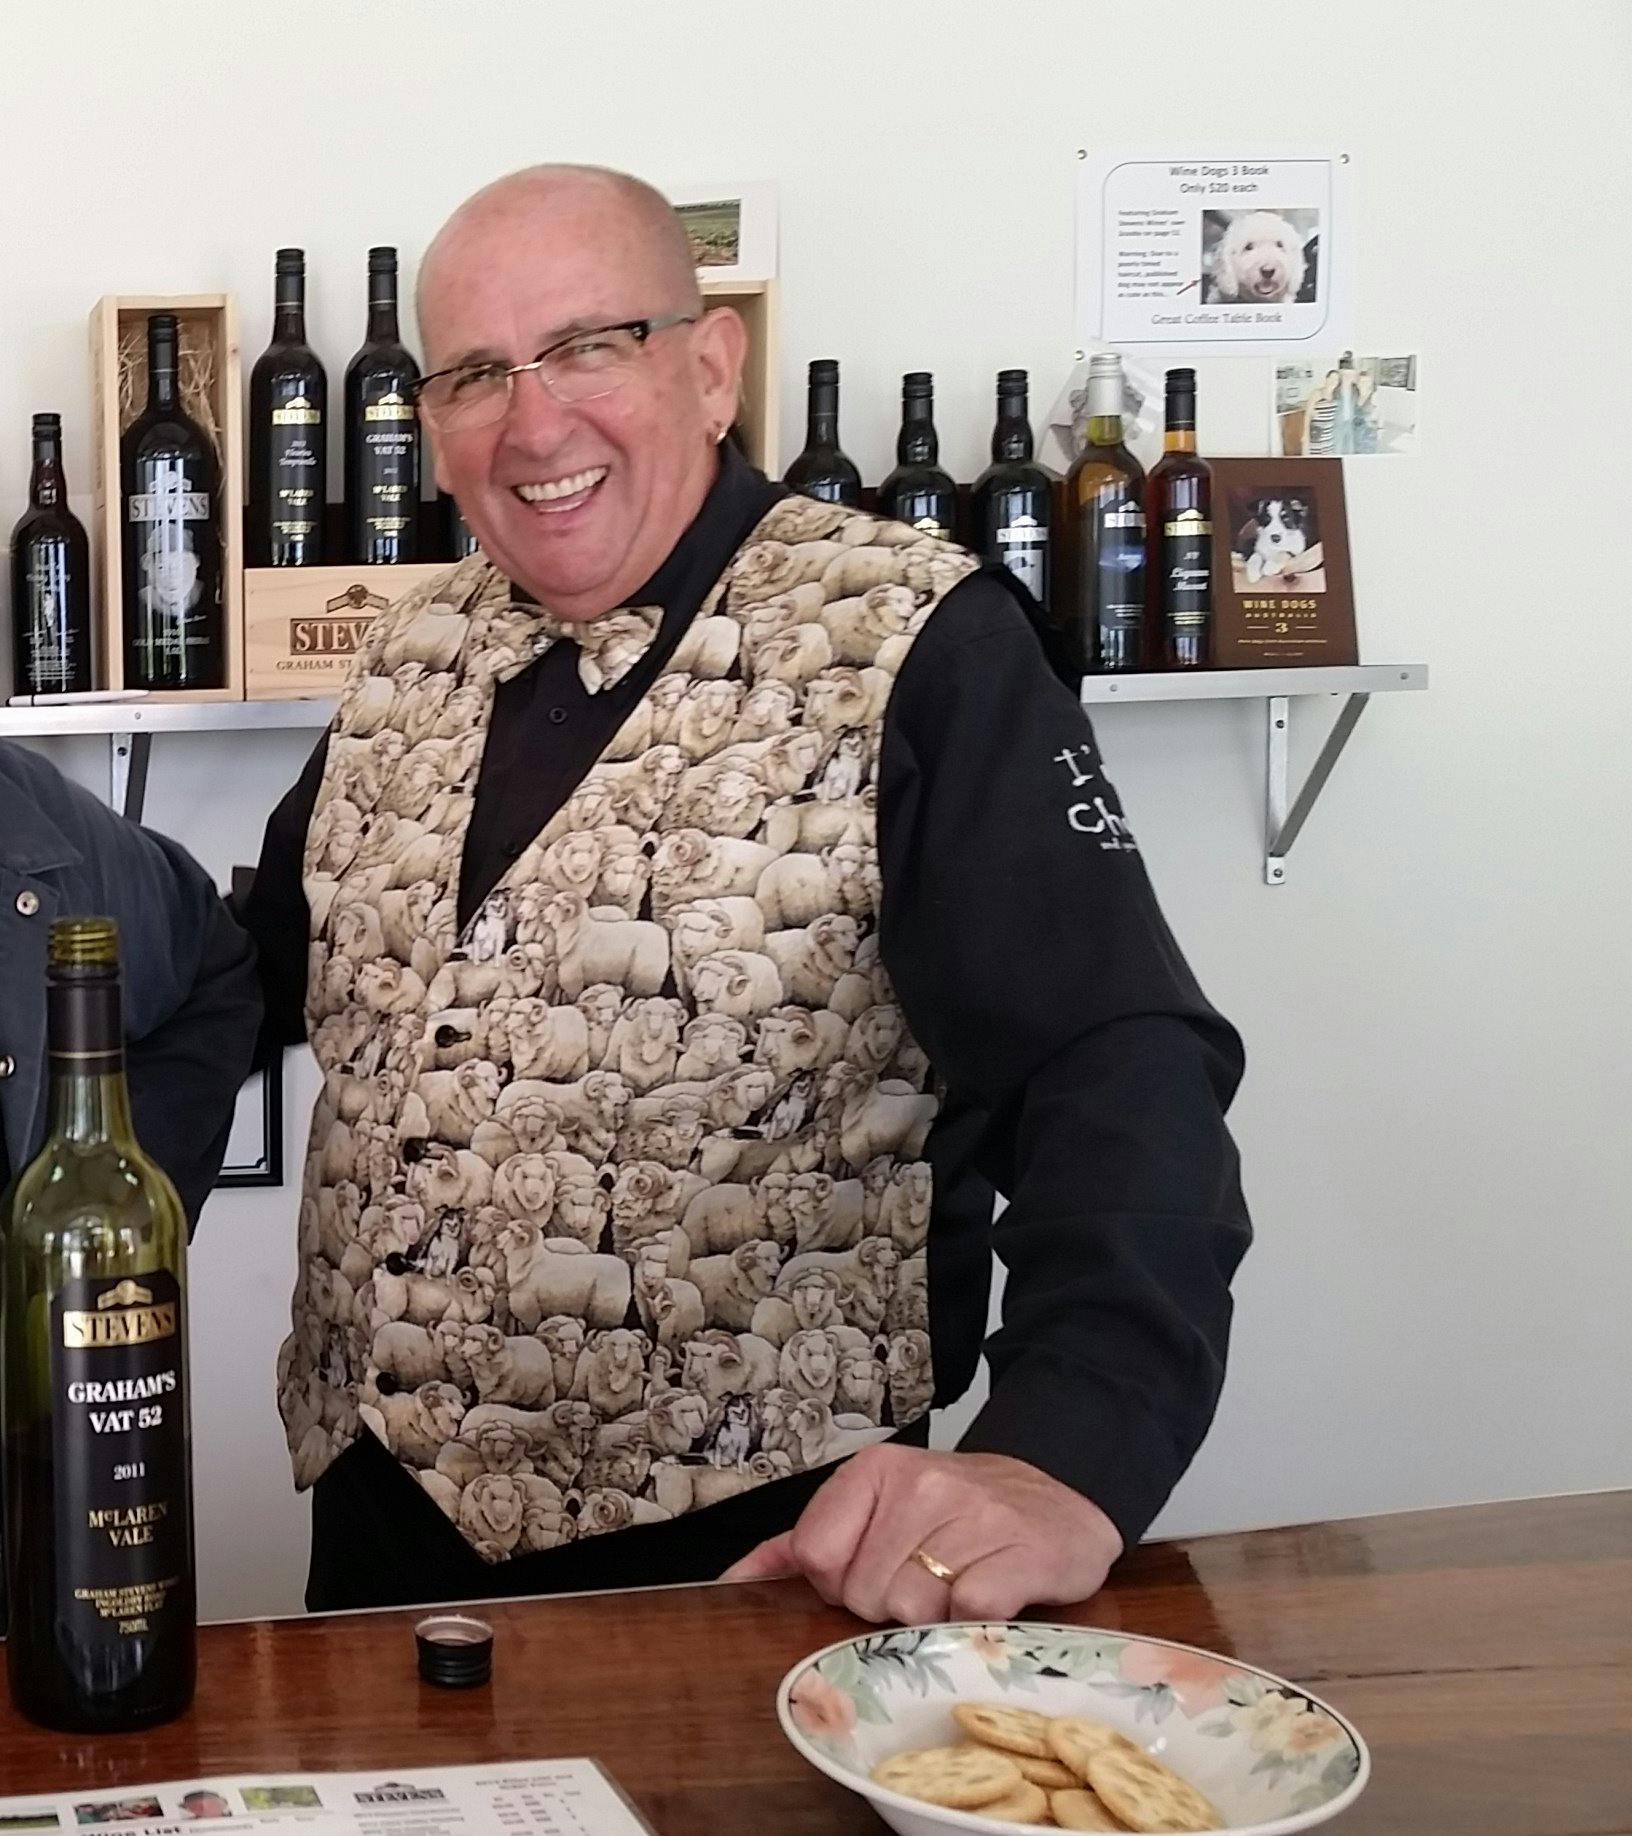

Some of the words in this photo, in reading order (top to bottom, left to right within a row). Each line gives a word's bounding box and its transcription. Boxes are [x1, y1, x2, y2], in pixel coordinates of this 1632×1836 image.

[1170, 166, 1197, 176] Wine
[1201, 166, 1229, 178] Dogs
[1232, 166, 1239, 176] 3
[1242, 165, 1269, 176] Book
[1180, 183, 1206, 195] Only
[1209, 182, 1230, 194] $20
[1233, 183, 1259, 193] each
[1151, 313, 1182, 325] Great
[1185, 313, 1219, 324] Coffee
[1222, 312, 1253, 324] Table
[1255, 312, 1282, 323] Book
[132, 497, 207, 517] STVENS
[1243, 599, 1276, 609] WINE
[1281, 599, 1317, 609] DOGS
[1275, 622, 1289, 634] 3
[276, 660, 334, 671] GRAHAM
[1067, 796, 1126, 835] Ch
[71, 1311, 172, 1342] STEVENS
[67, 1369, 177, 1404] GRAHAM'S
[89, 1409, 136, 1434] VAT
[137, 1404, 164, 1429] 52
[113, 1461, 146, 1481] 2011
[88, 1501, 168, 1528] McLAREN
[109, 1525, 154, 1547] VALE
